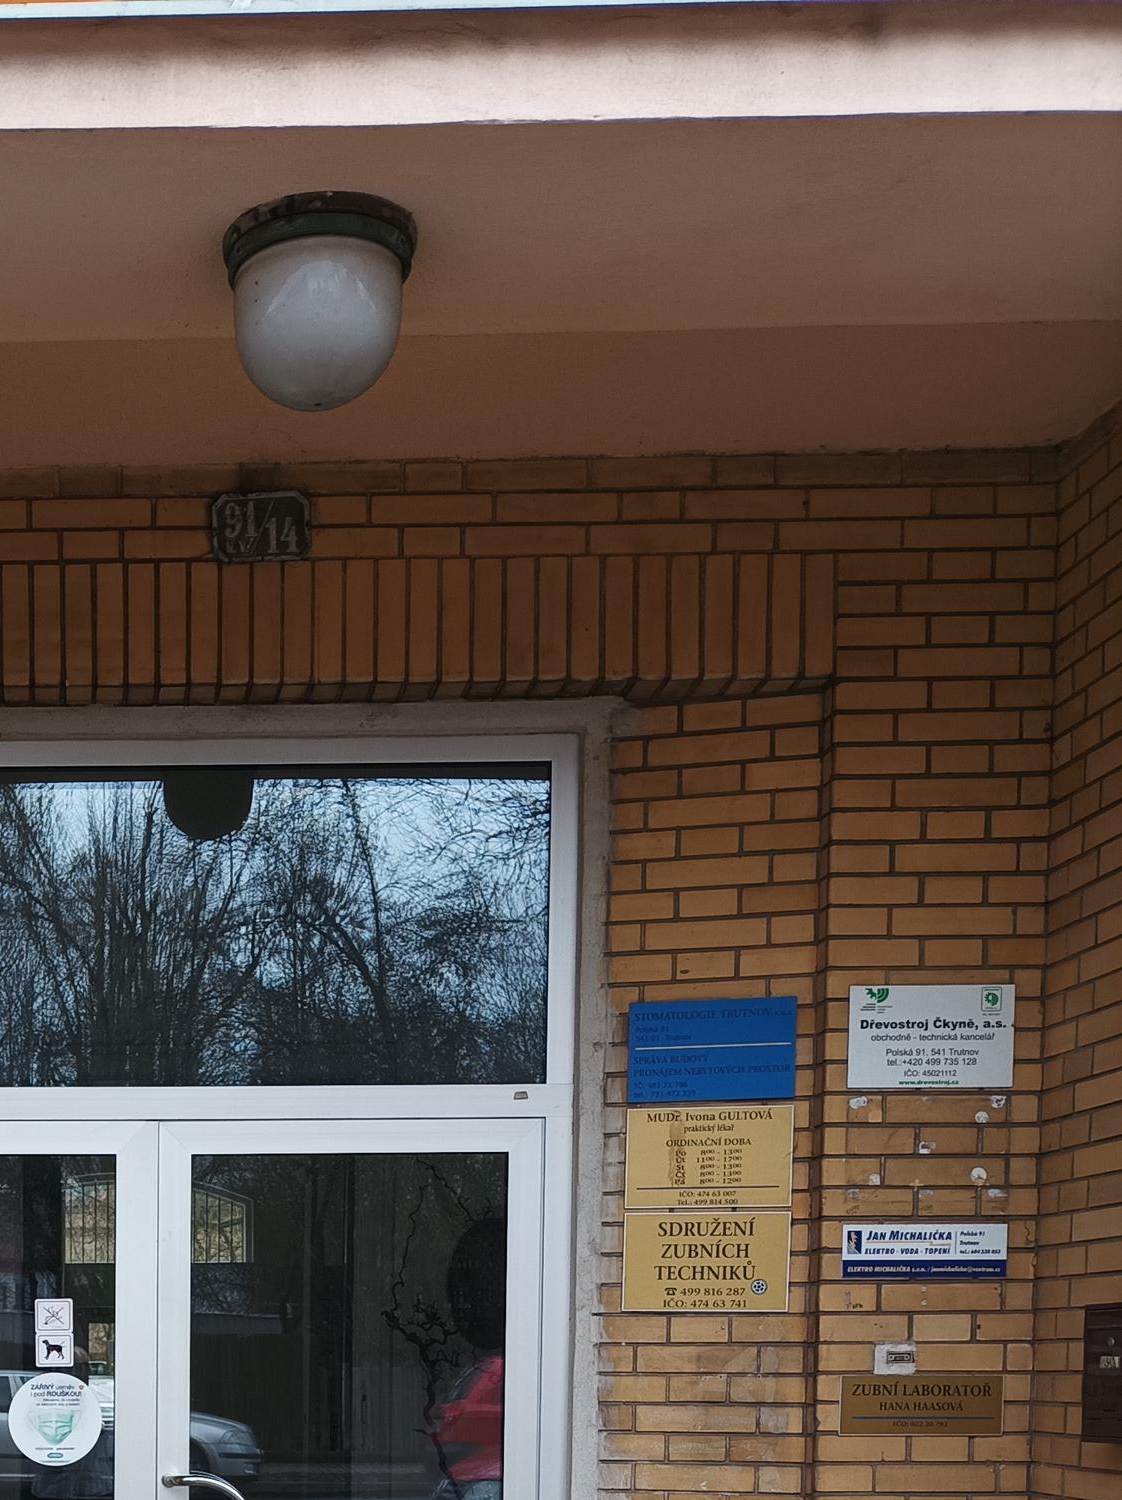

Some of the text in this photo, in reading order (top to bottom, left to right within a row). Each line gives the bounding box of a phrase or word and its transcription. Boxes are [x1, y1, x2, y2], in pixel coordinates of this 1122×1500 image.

[861, 1019, 929, 1030] Dřevostroj
[934, 1017, 978, 1030] Čkyně,
[871, 1033, 911, 1041] obchodně
[960, 1032, 995, 1040] kancelář
[886, 1048, 913, 1056] Polská
[931, 1048, 945, 1056] 541
[647, 1108, 772, 1123] MUDr. Ivona GULTOVÁ
[684, 1123, 734, 1133] praktický lékař
[666, 1137, 722, 1147] ORDINAČNÍ
[658, 1217, 756, 1236] SDRUŽENÍ
[866, 1230, 952, 1241] JAN MICHALIČKA
[661, 1239, 750, 1258] ZUBNÍCH
[654, 1261, 757, 1280] TECHNIKŮ
[680, 1288, 700, 1296] 499
[663, 1298, 687, 1307] IČO:
[730, 1299, 747, 1307] 741
[852, 1381, 991, 1396] ZUBNÍ LABORATOŘ
[879, 1400, 963, 1411] HANA HAASOVÁ
